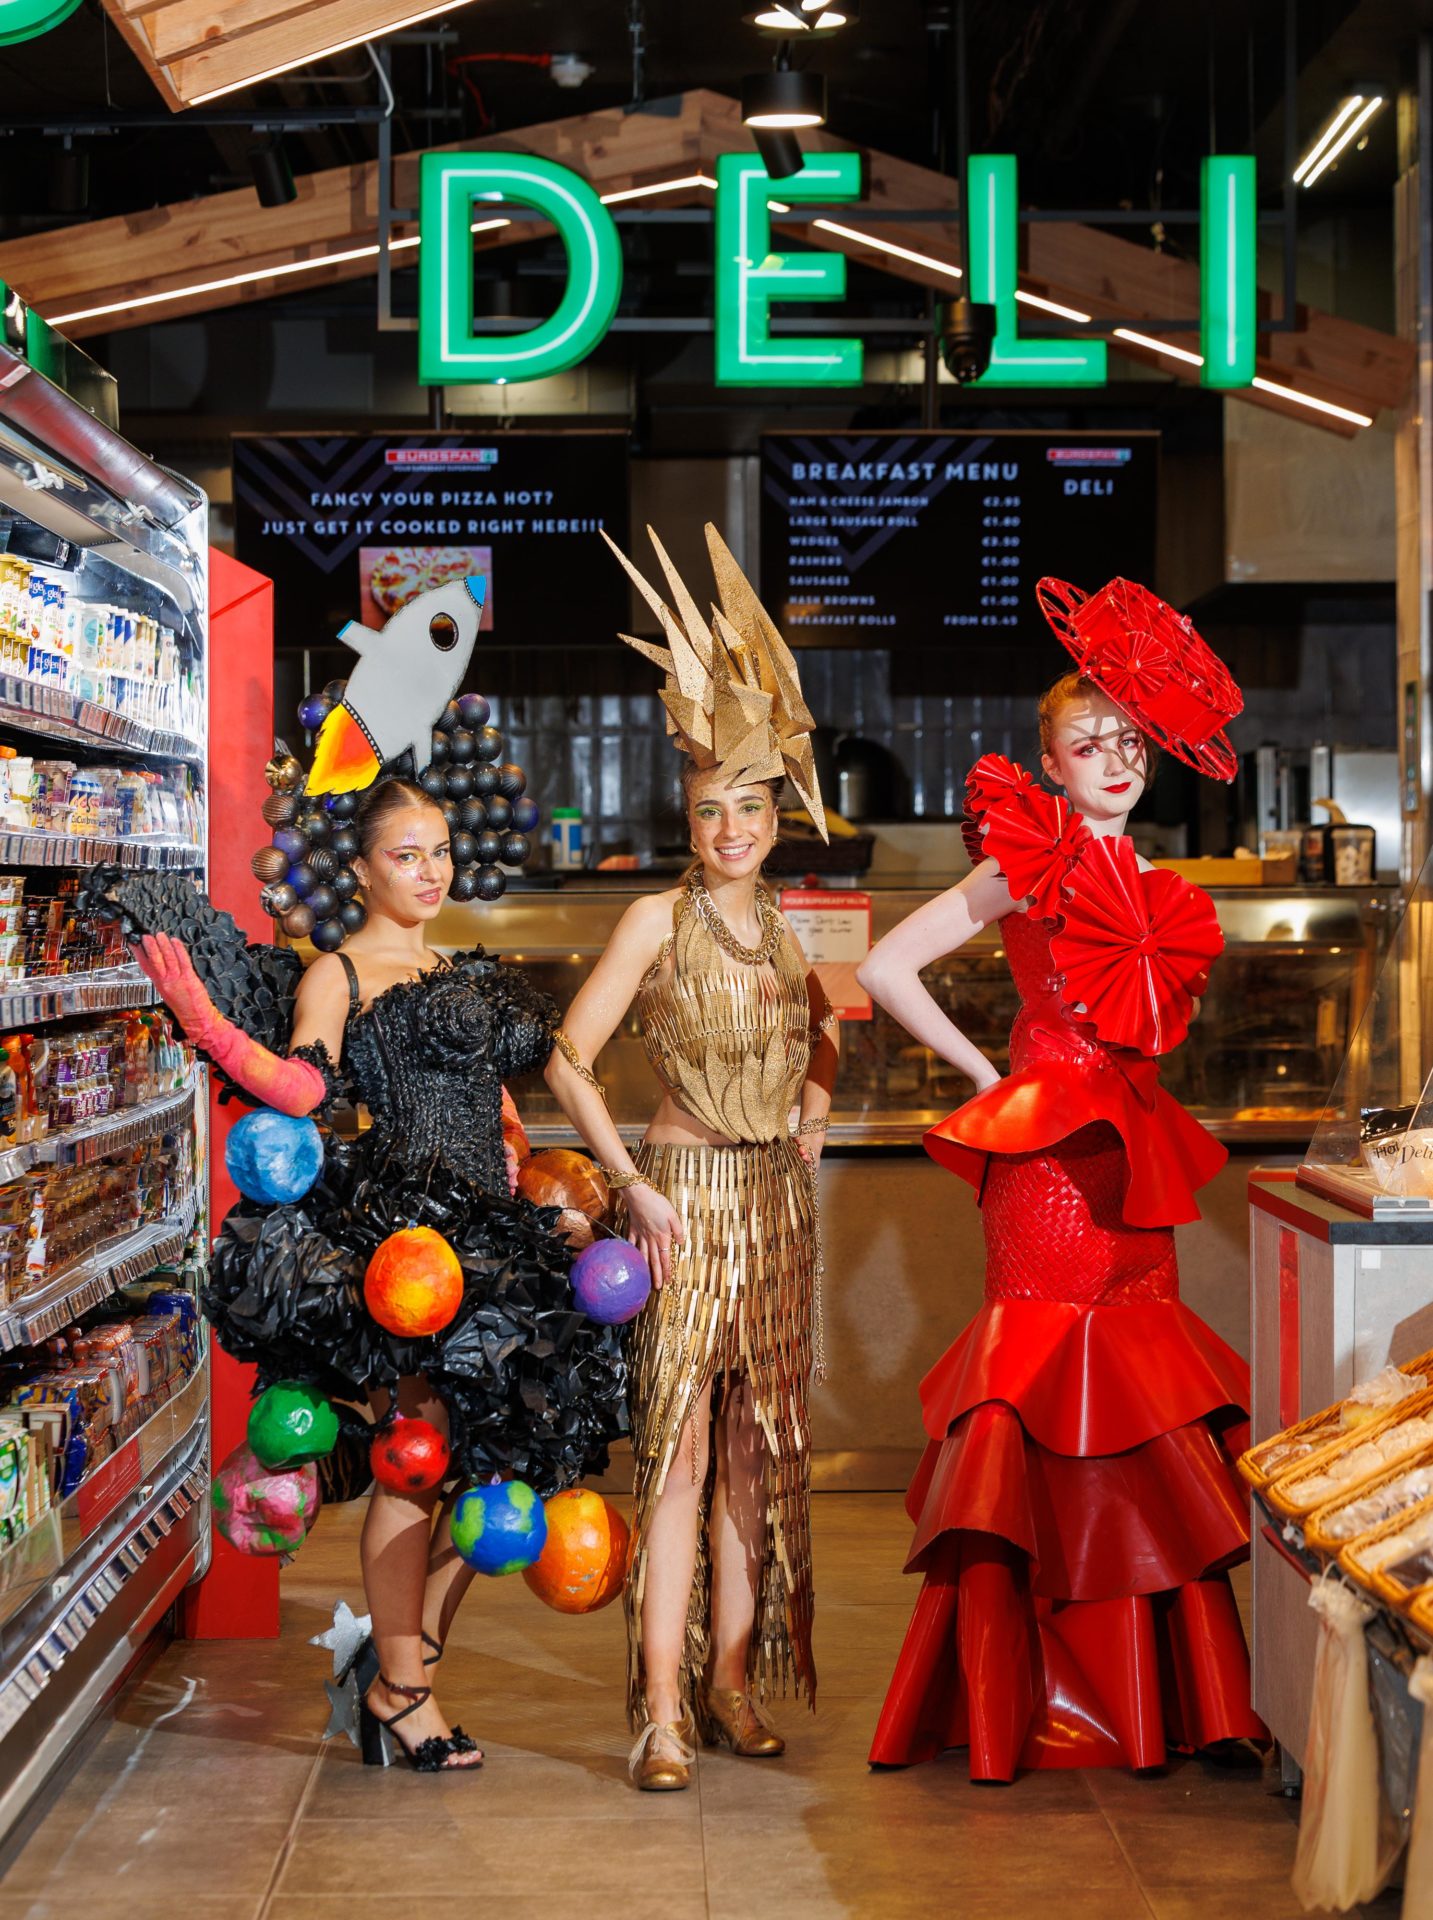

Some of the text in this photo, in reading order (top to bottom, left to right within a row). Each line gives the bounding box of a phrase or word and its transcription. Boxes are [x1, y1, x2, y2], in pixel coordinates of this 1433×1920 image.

[419, 151, 1257, 389] DELI
[791, 462, 1019, 481] BREAKFAST MENU
[1064, 479, 1114, 495] DELI
[311, 491, 554, 506] FANCY YOUR PIZZA HOT?
[789, 496, 817, 507] HAM
[830, 496, 875, 507] CHEESE
[262, 519, 604, 535] JUST GET IT COOKED RIGHT HERE!!!
[789, 516, 918, 527] LARGE SAUSAGE ROLL
[789, 536, 839, 546] WEDGES
[789, 556, 842, 566] RASHERS
[789, 576, 850, 586] SAUSAGES
[823, 595, 876, 606] BROWNS
[789, 615, 896, 626] BREAKFAST ROLLS
[943, 615, 978, 626] FROM
